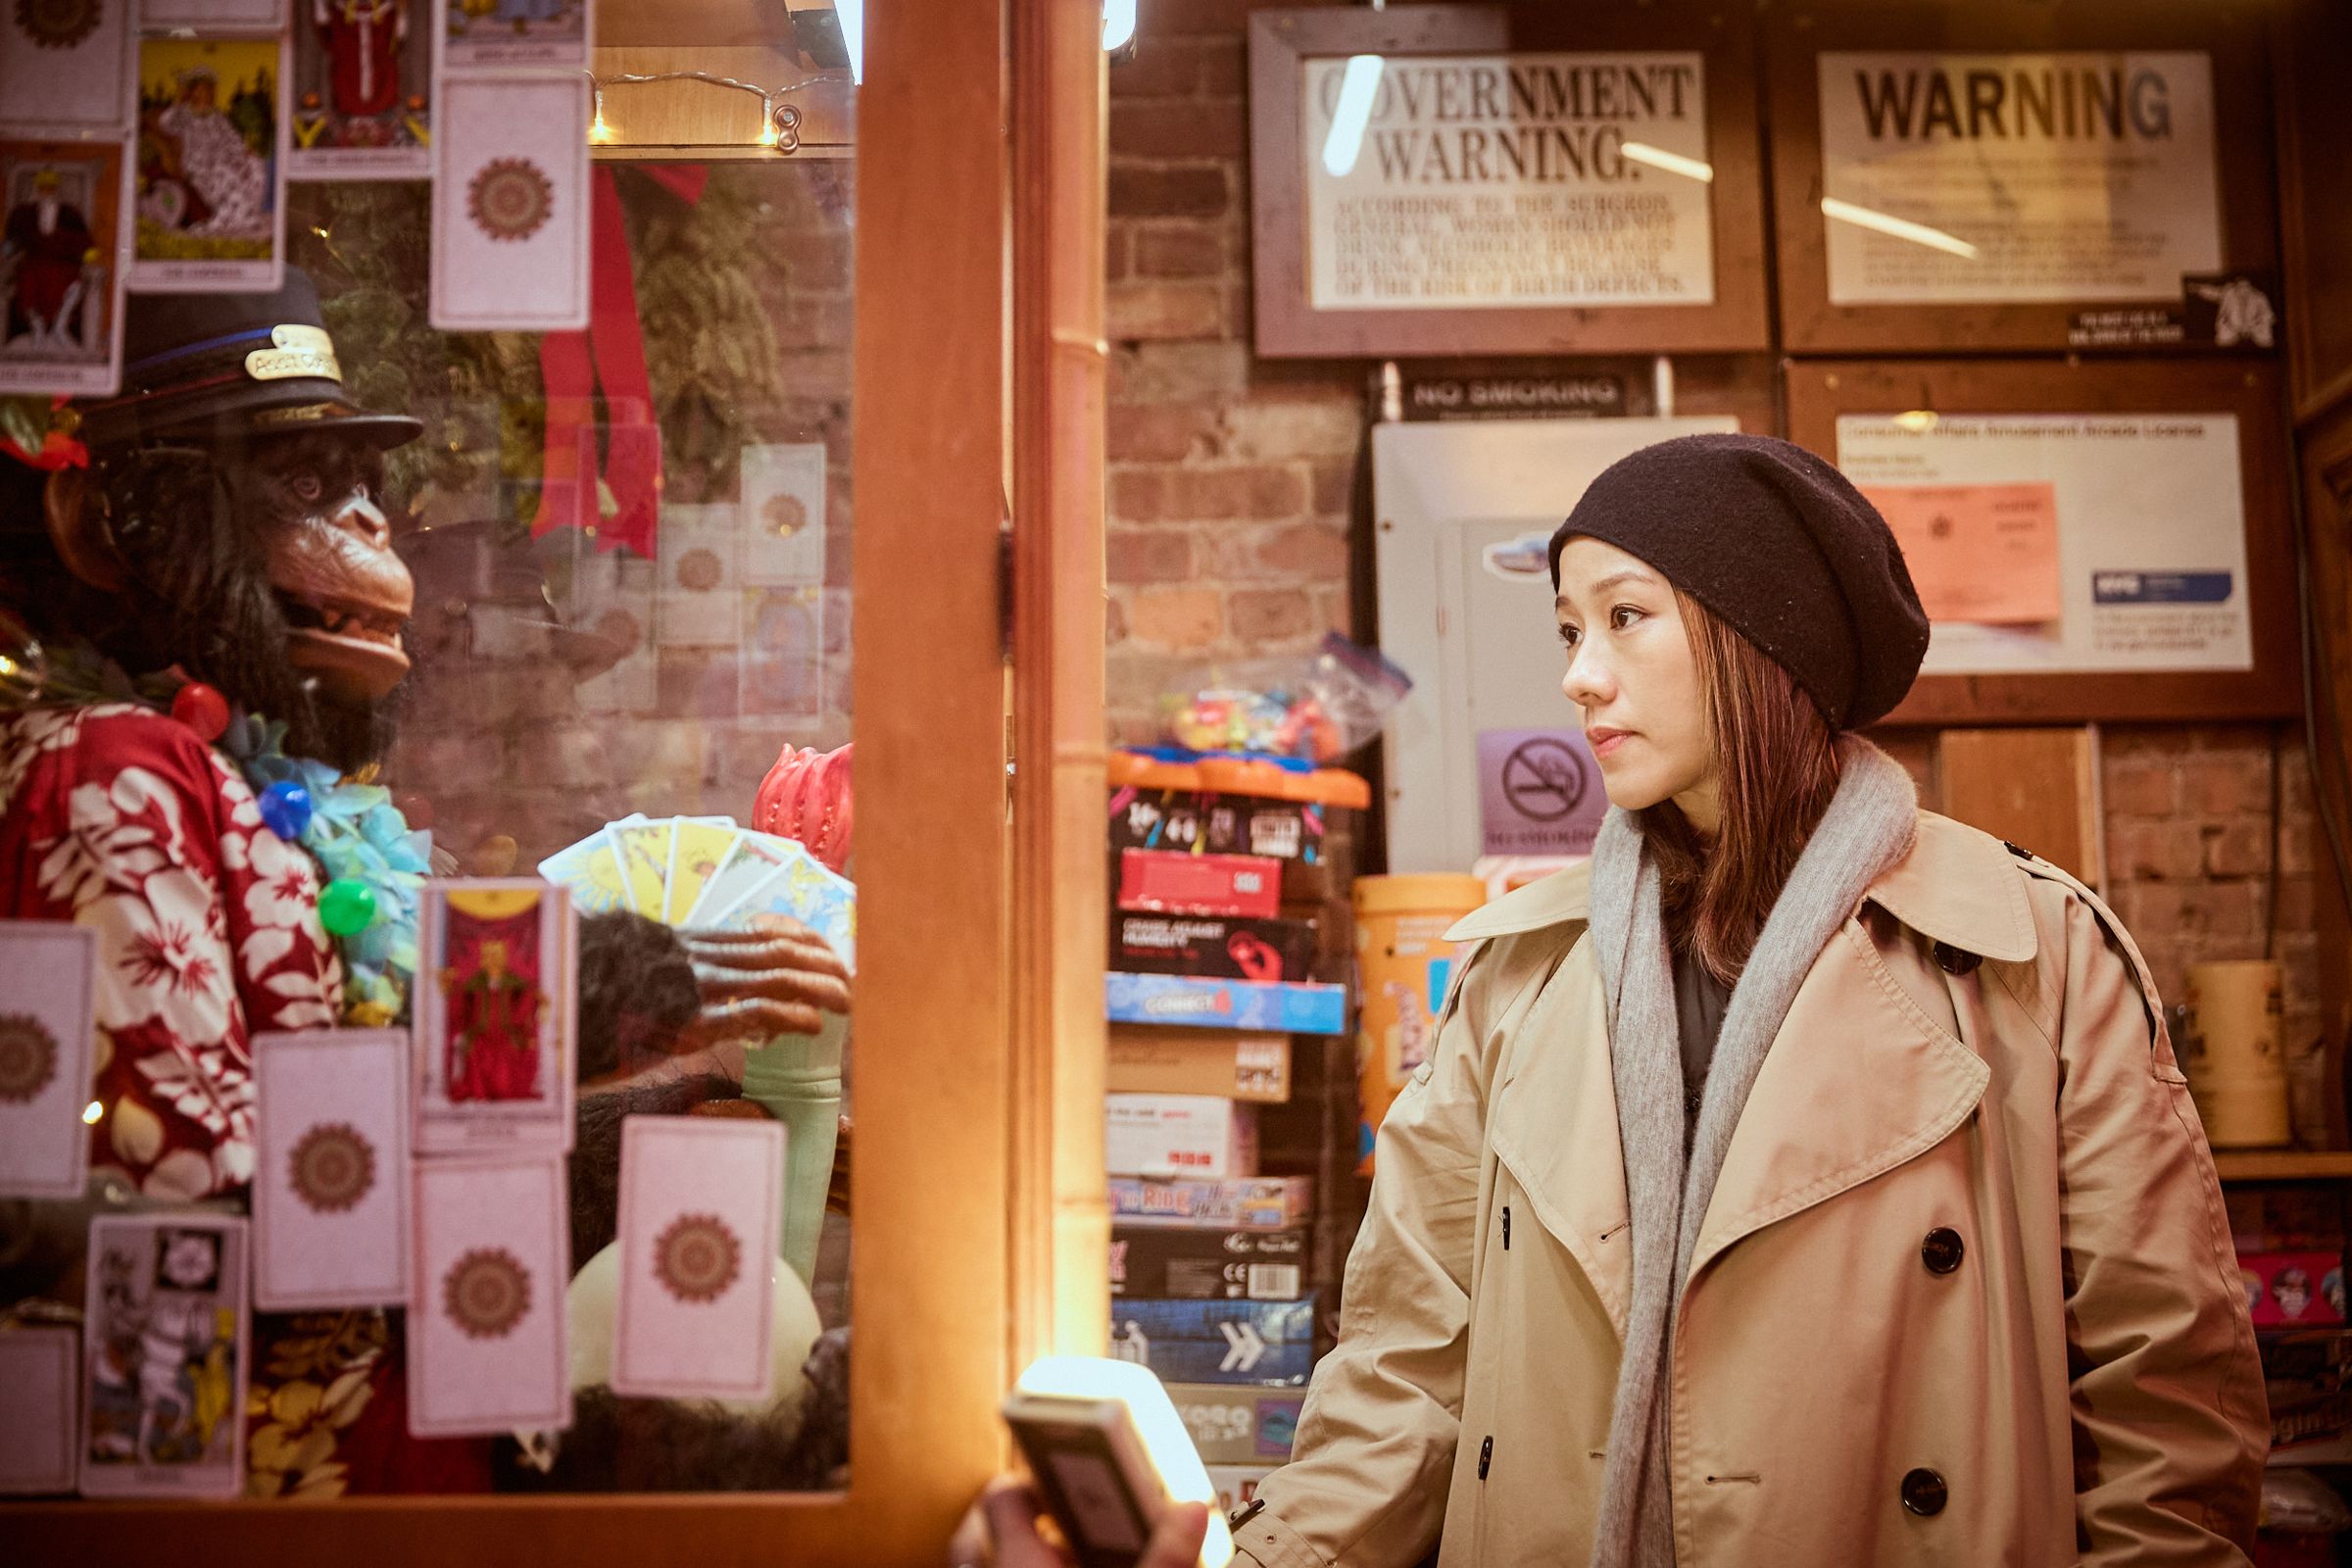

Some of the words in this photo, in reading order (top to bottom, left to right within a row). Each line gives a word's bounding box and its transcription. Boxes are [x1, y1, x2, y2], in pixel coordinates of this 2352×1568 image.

[1855, 67, 2172, 141] WARNING
[1373, 124, 1641, 183] WARNING.
[1413, 382, 1463, 407] NO
[1469, 379, 1618, 405] SMOKING
